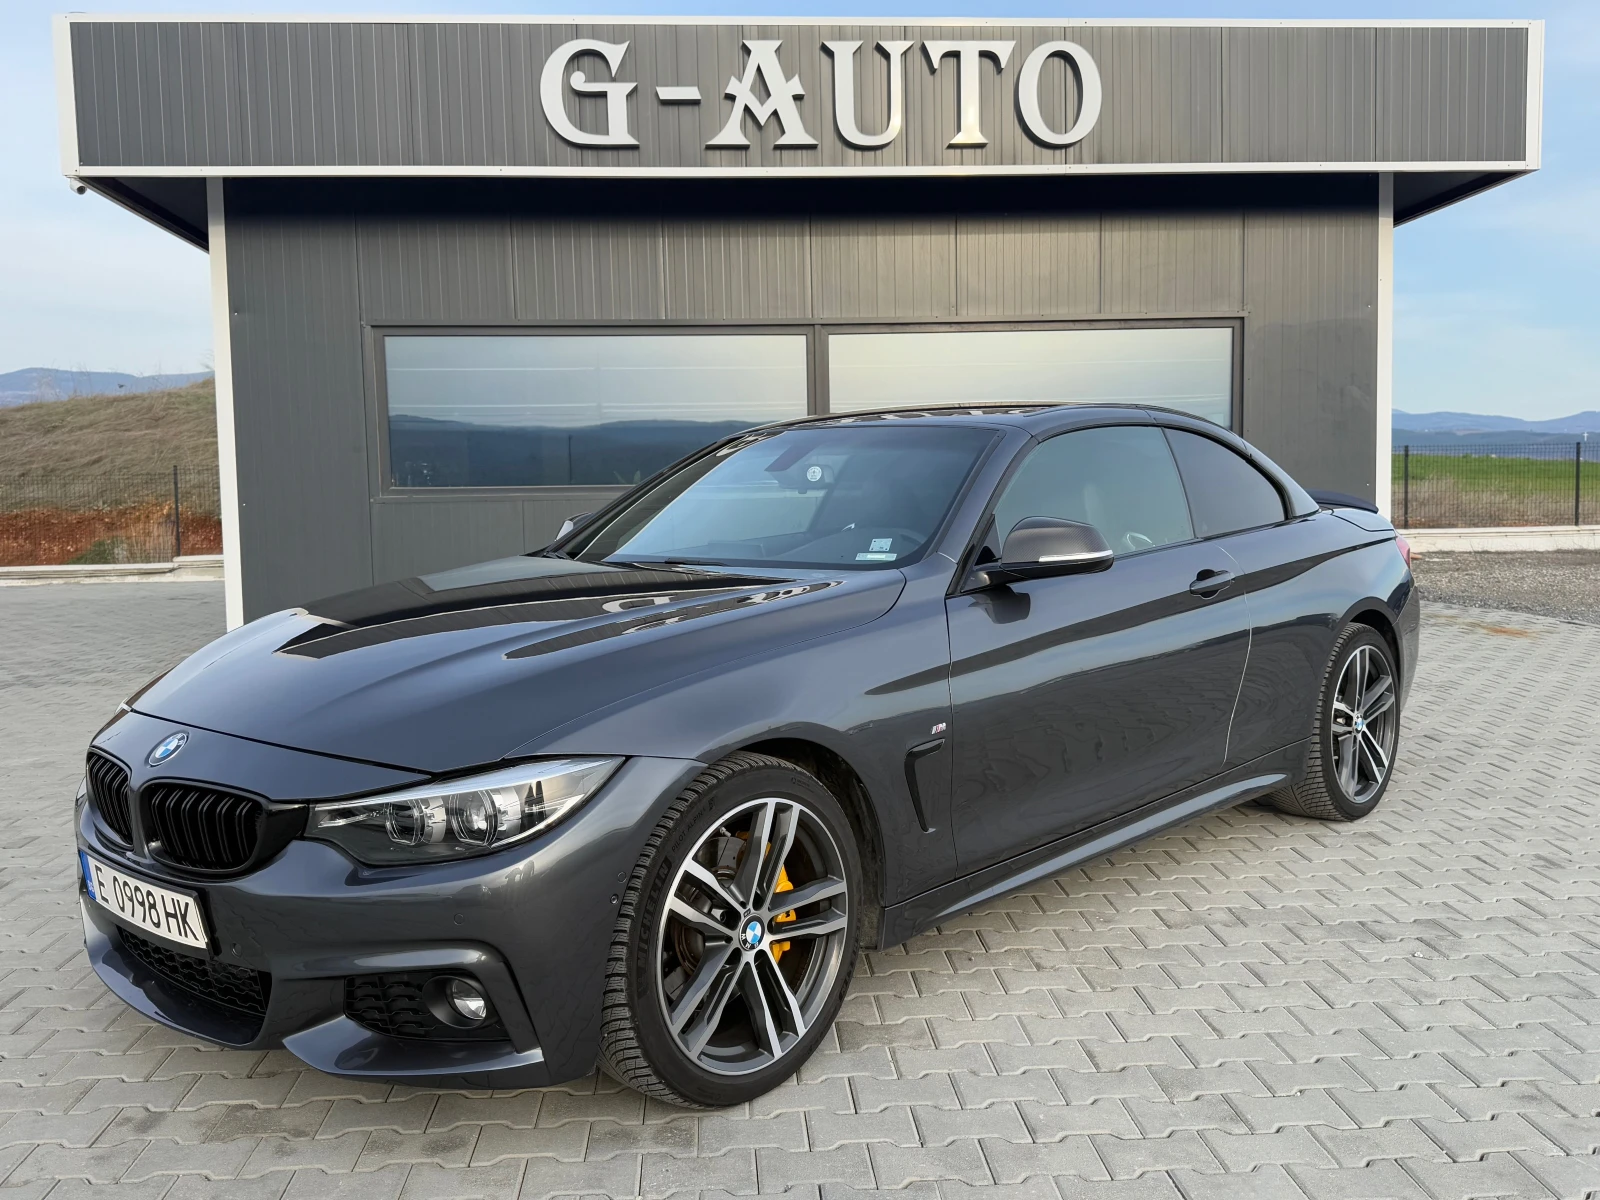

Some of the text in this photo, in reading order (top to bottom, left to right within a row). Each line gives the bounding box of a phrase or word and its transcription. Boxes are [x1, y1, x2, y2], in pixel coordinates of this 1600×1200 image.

[539, 38, 1103, 151] G-AUTO
[672, 831, 687, 853] PILOT
[94, 864, 200, 942] E 0998 HK
[636, 862, 669, 970] MICHELIN
